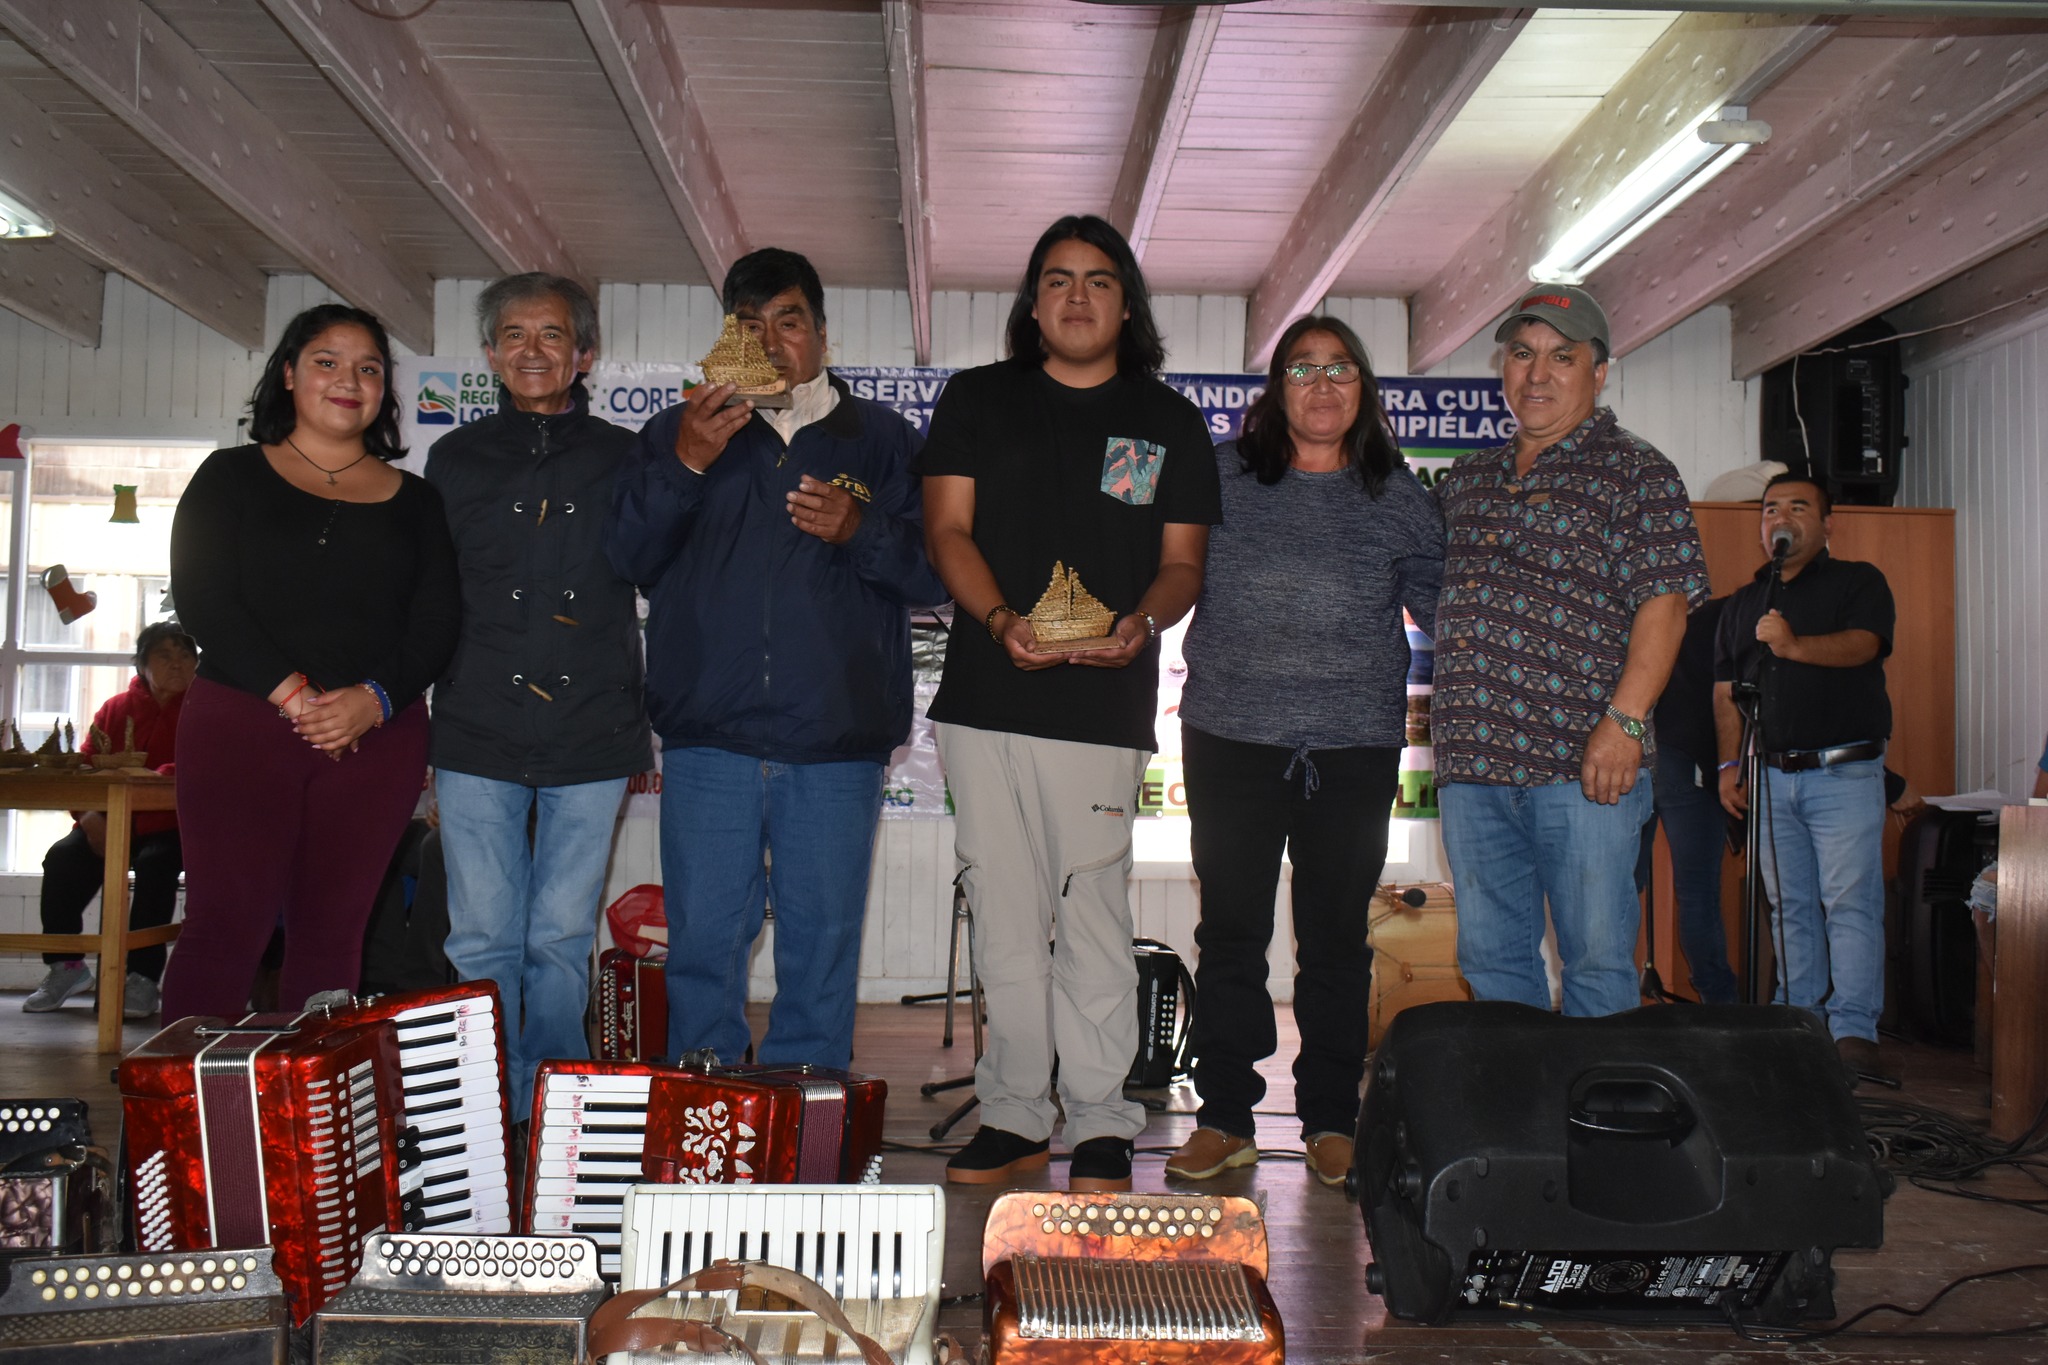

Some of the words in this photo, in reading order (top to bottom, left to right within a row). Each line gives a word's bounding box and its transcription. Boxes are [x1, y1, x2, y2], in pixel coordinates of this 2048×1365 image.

[610, 387, 678, 413] CORE
[850, 380, 948, 402] SERV
[1171, 386, 1266, 409] ANDO
[1378, 389, 1427, 411] RA
[1539, 1260, 1566, 1293] ALTO
